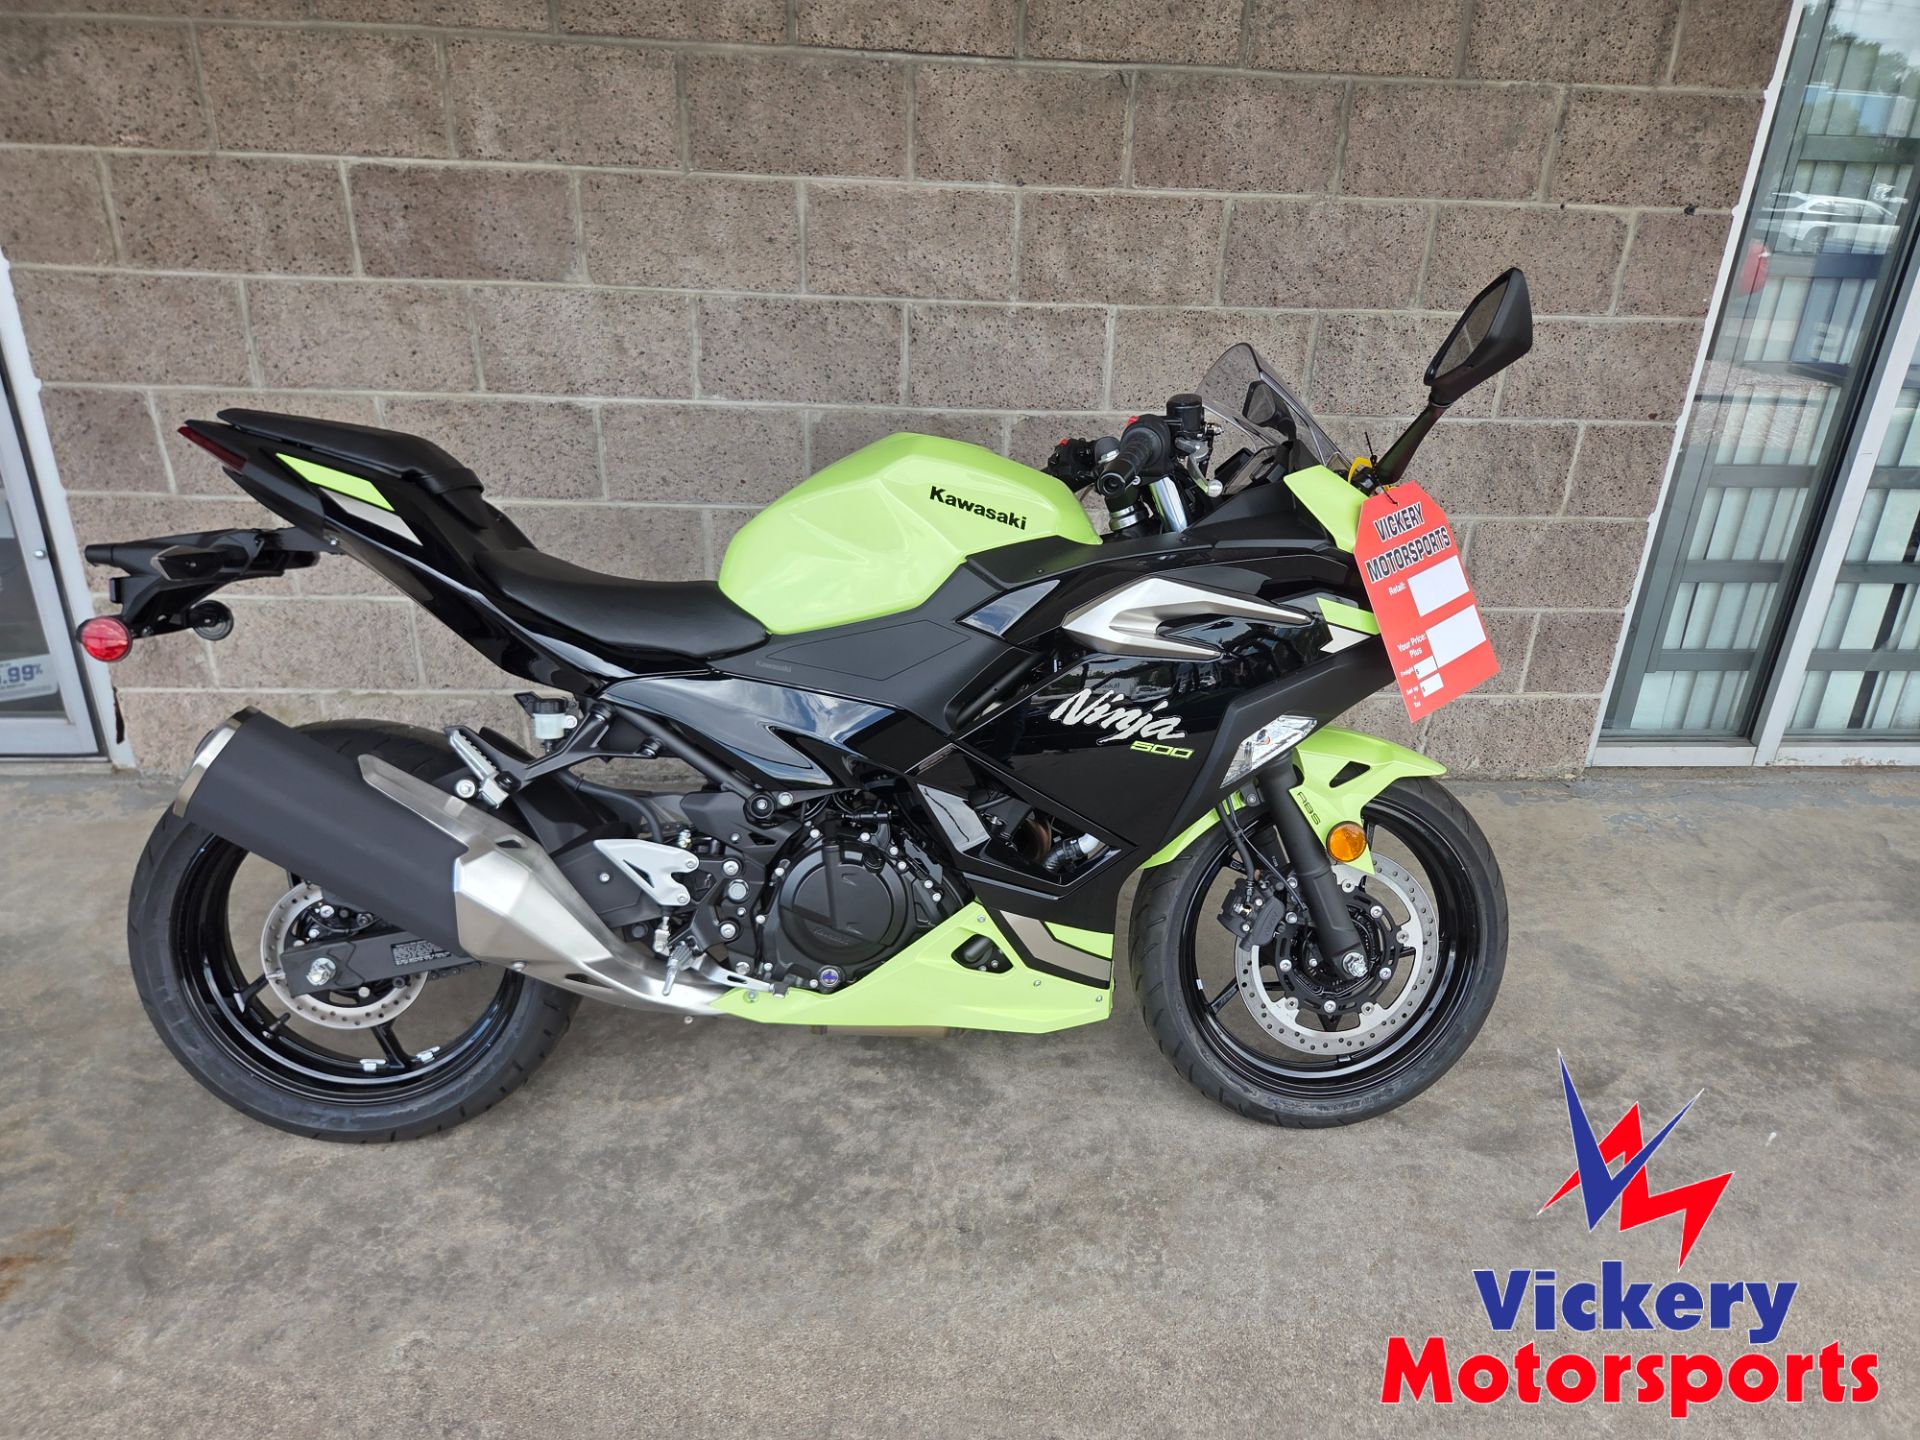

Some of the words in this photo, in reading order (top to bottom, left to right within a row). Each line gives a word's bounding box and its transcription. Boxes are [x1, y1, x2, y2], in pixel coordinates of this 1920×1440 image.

[929, 485, 1027, 531] Kawasaki
[1373, 502, 1425, 543] VICKERY
[1364, 526, 1452, 584] MOTORSPORTS
[0, 664, 43, 685] .99%
[1048, 688, 1187, 745] Ninja
[1130, 740, 1195, 760] 500
[1297, 791, 1321, 826] ABS
